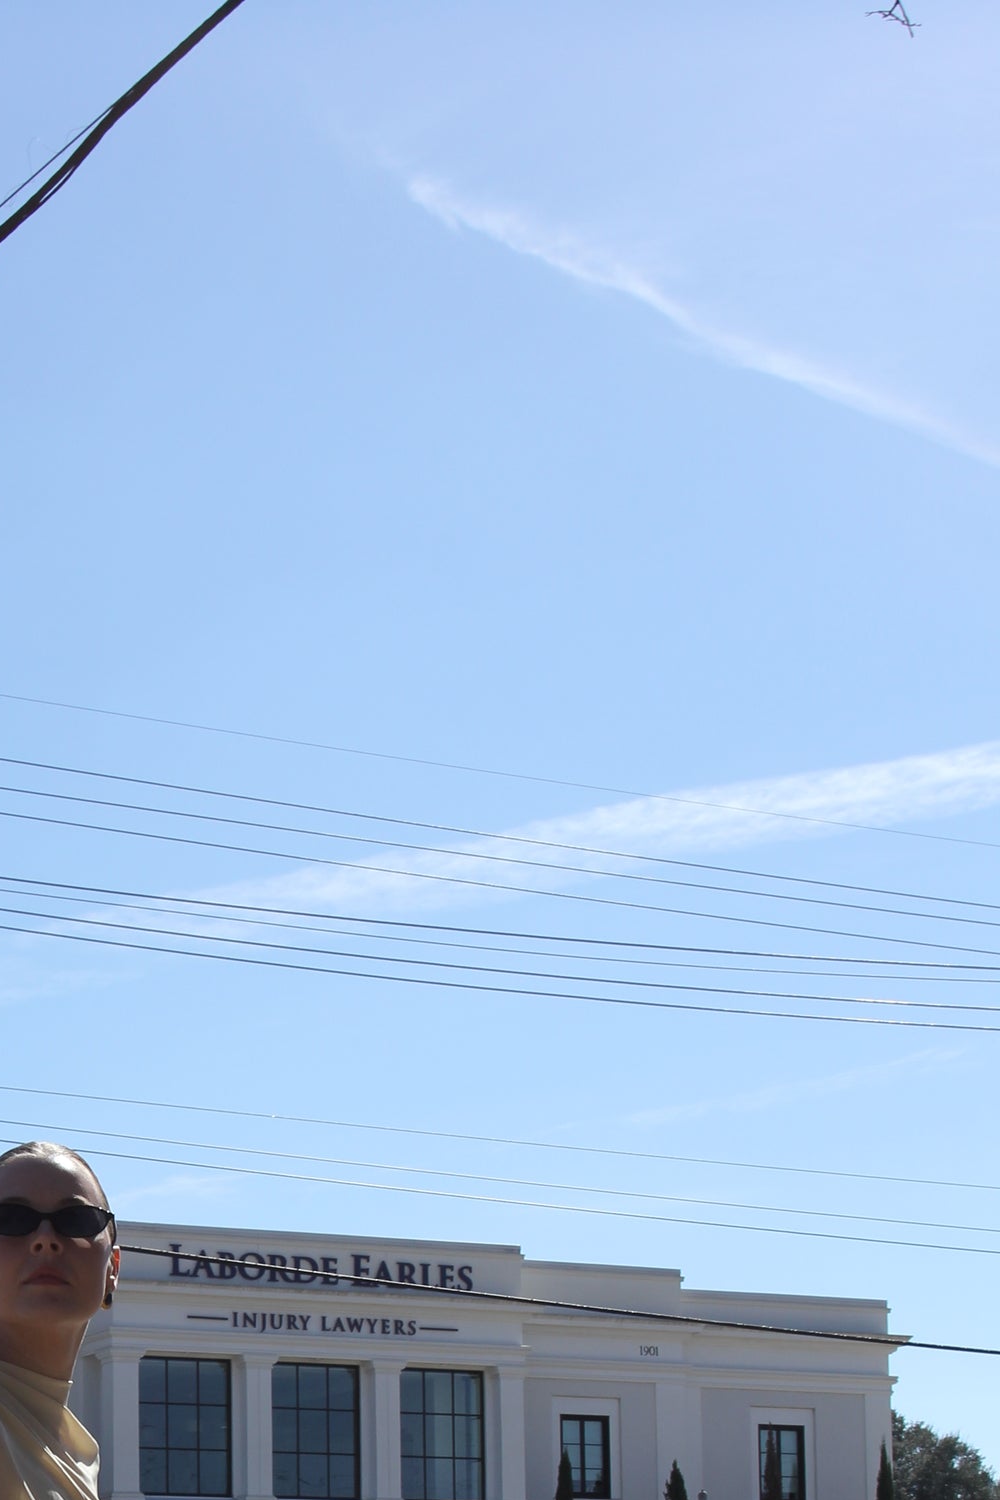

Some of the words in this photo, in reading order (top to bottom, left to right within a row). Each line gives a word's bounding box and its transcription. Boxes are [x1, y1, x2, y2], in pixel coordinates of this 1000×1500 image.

[169, 1243, 339, 1285] LABORDE
[351, 1254, 473, 1292] EARLES
[232, 1311, 311, 1333] INJURY
[320, 1316, 417, 1336] LAWYERS
[639, 1345, 659, 1357] 1901
